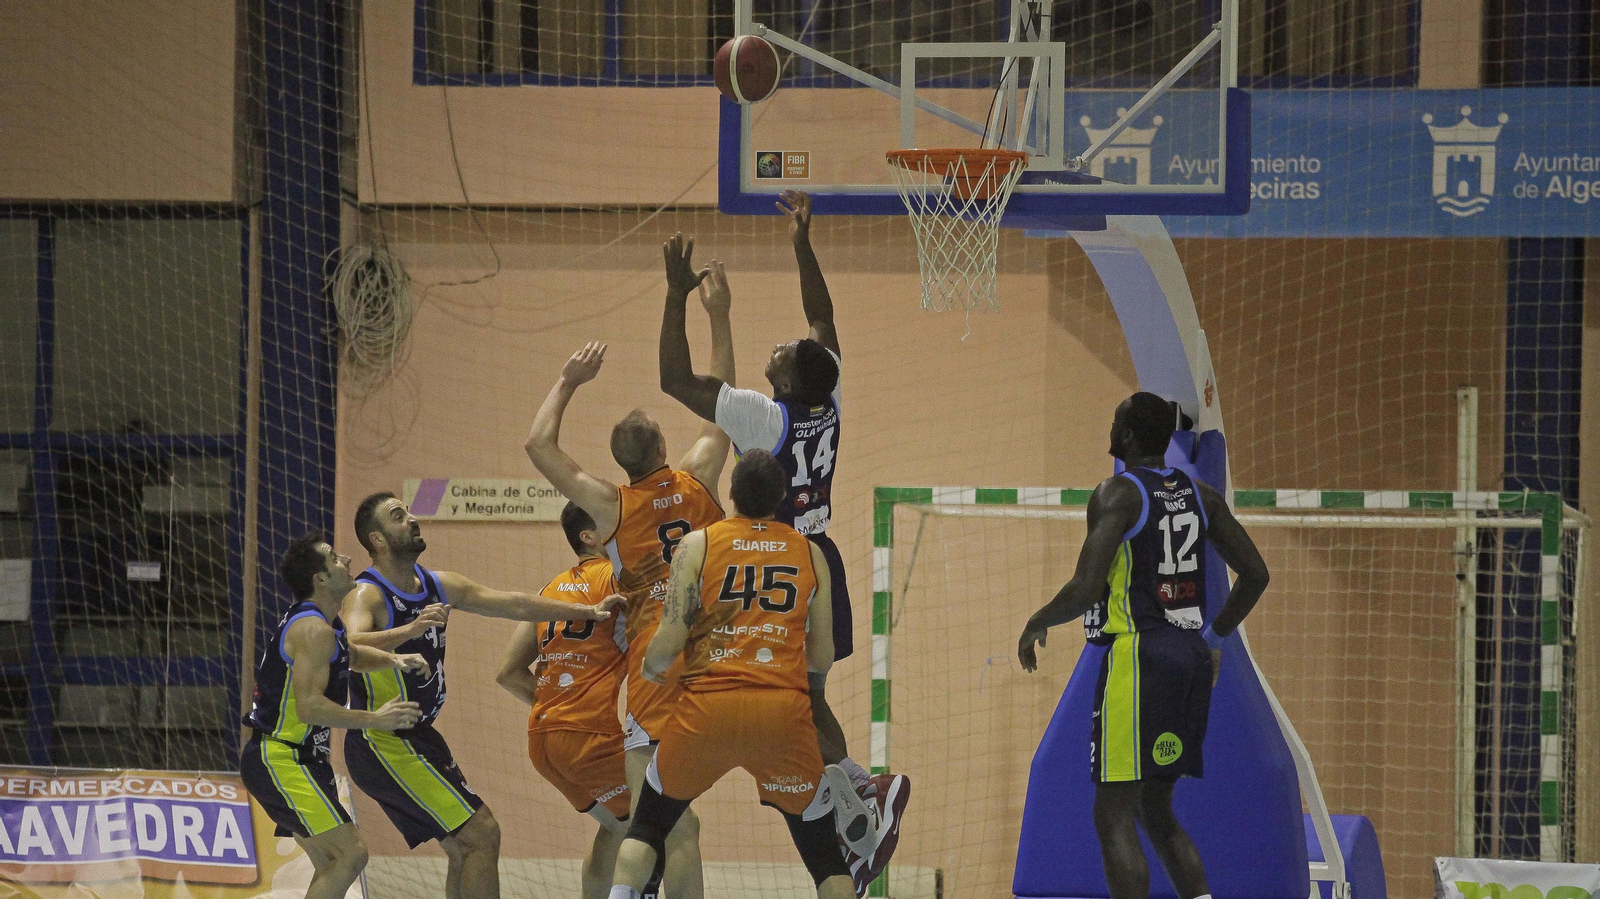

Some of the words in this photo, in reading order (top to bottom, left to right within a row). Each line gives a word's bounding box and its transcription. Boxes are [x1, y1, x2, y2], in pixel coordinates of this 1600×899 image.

[787, 155, 805, 164] FIBA
[1513, 180, 1539, 198] de
[791, 426, 836, 487] 14
[451, 485, 497, 498] Cabina
[503, 486, 520, 498] de
[451, 504, 459, 515] y
[657, 518, 692, 565] 8
[732, 539, 788, 552] SUAREZ
[1157, 511, 1199, 575] 12
[718, 564, 799, 614] 45
